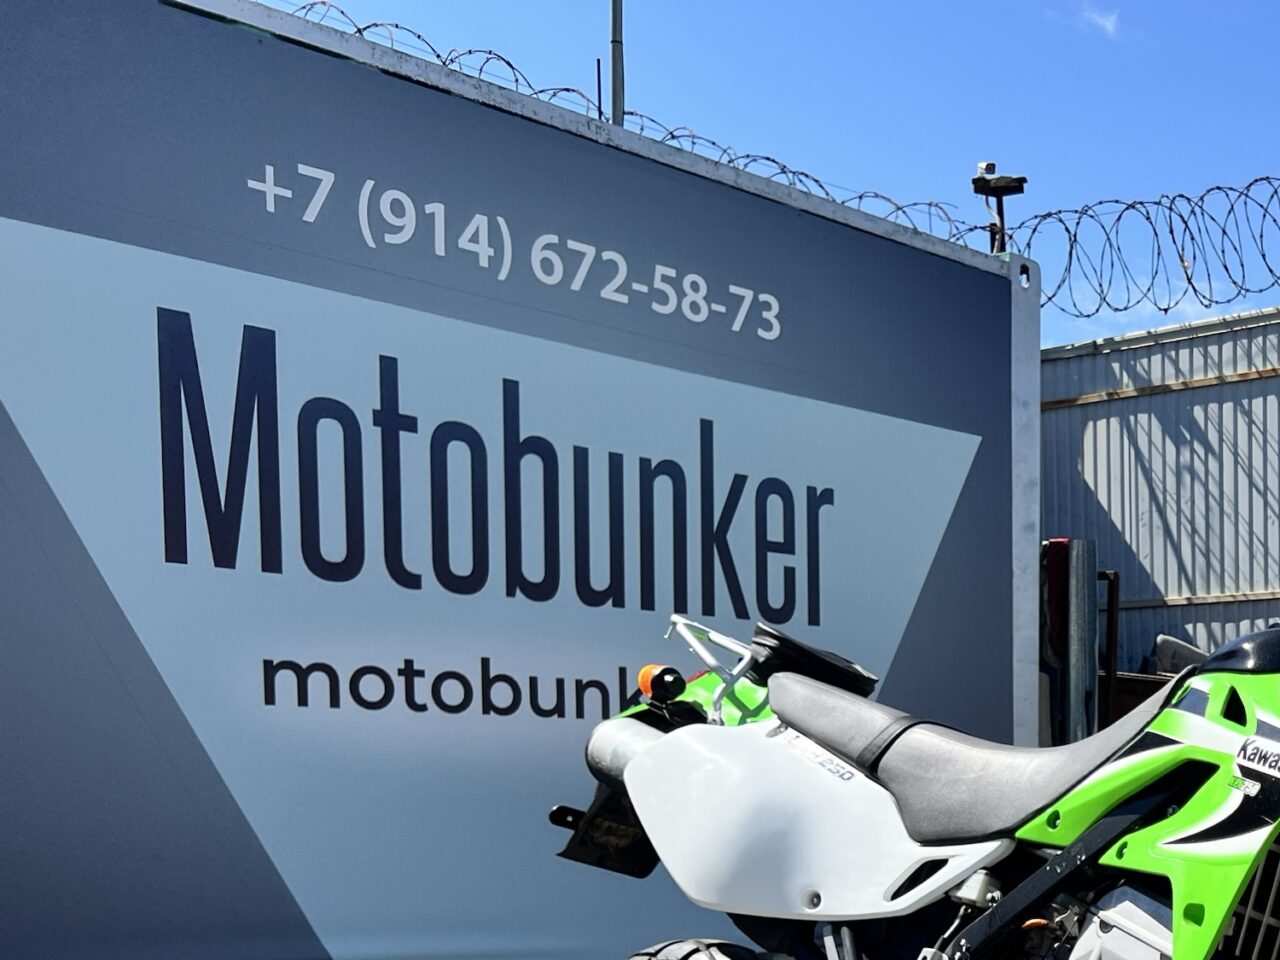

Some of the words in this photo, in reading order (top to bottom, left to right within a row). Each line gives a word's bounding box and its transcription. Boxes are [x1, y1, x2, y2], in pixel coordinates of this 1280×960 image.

[247, 163, 335, 223] +7
[358, 179, 513, 281] (914)
[530, 233, 782, 341] 672-58-73
[156, 305, 835, 627] Motobunker
